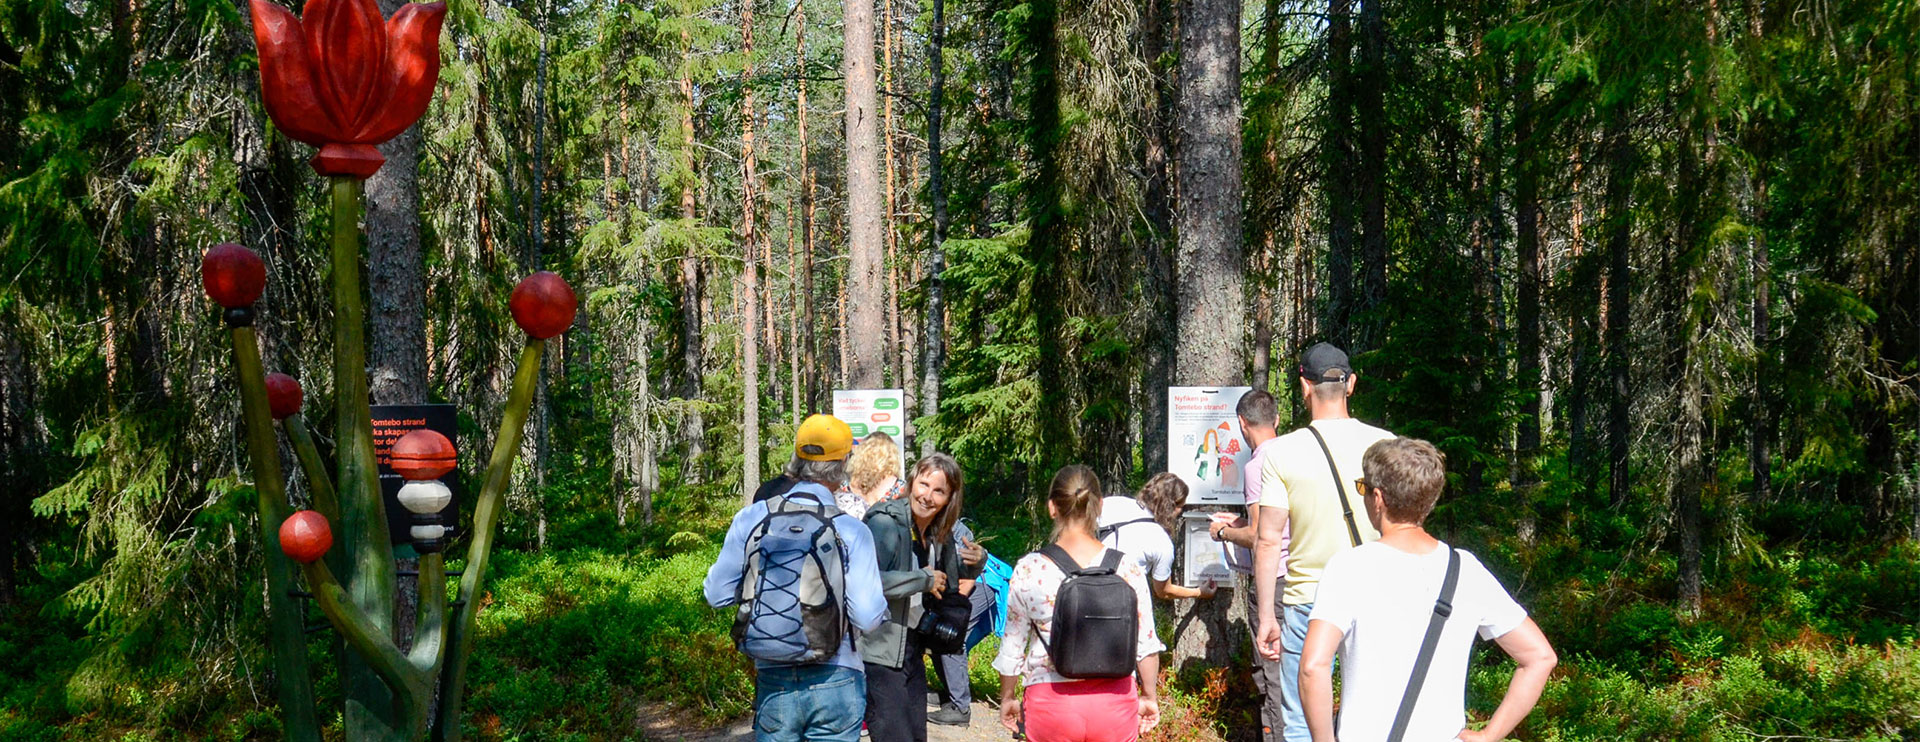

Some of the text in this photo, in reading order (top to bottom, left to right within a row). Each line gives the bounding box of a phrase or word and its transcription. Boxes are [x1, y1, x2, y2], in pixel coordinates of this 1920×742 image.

[402, 417, 426, 426] strand
[373, 428, 383, 436] ka
[374, 438, 384, 446] tor
